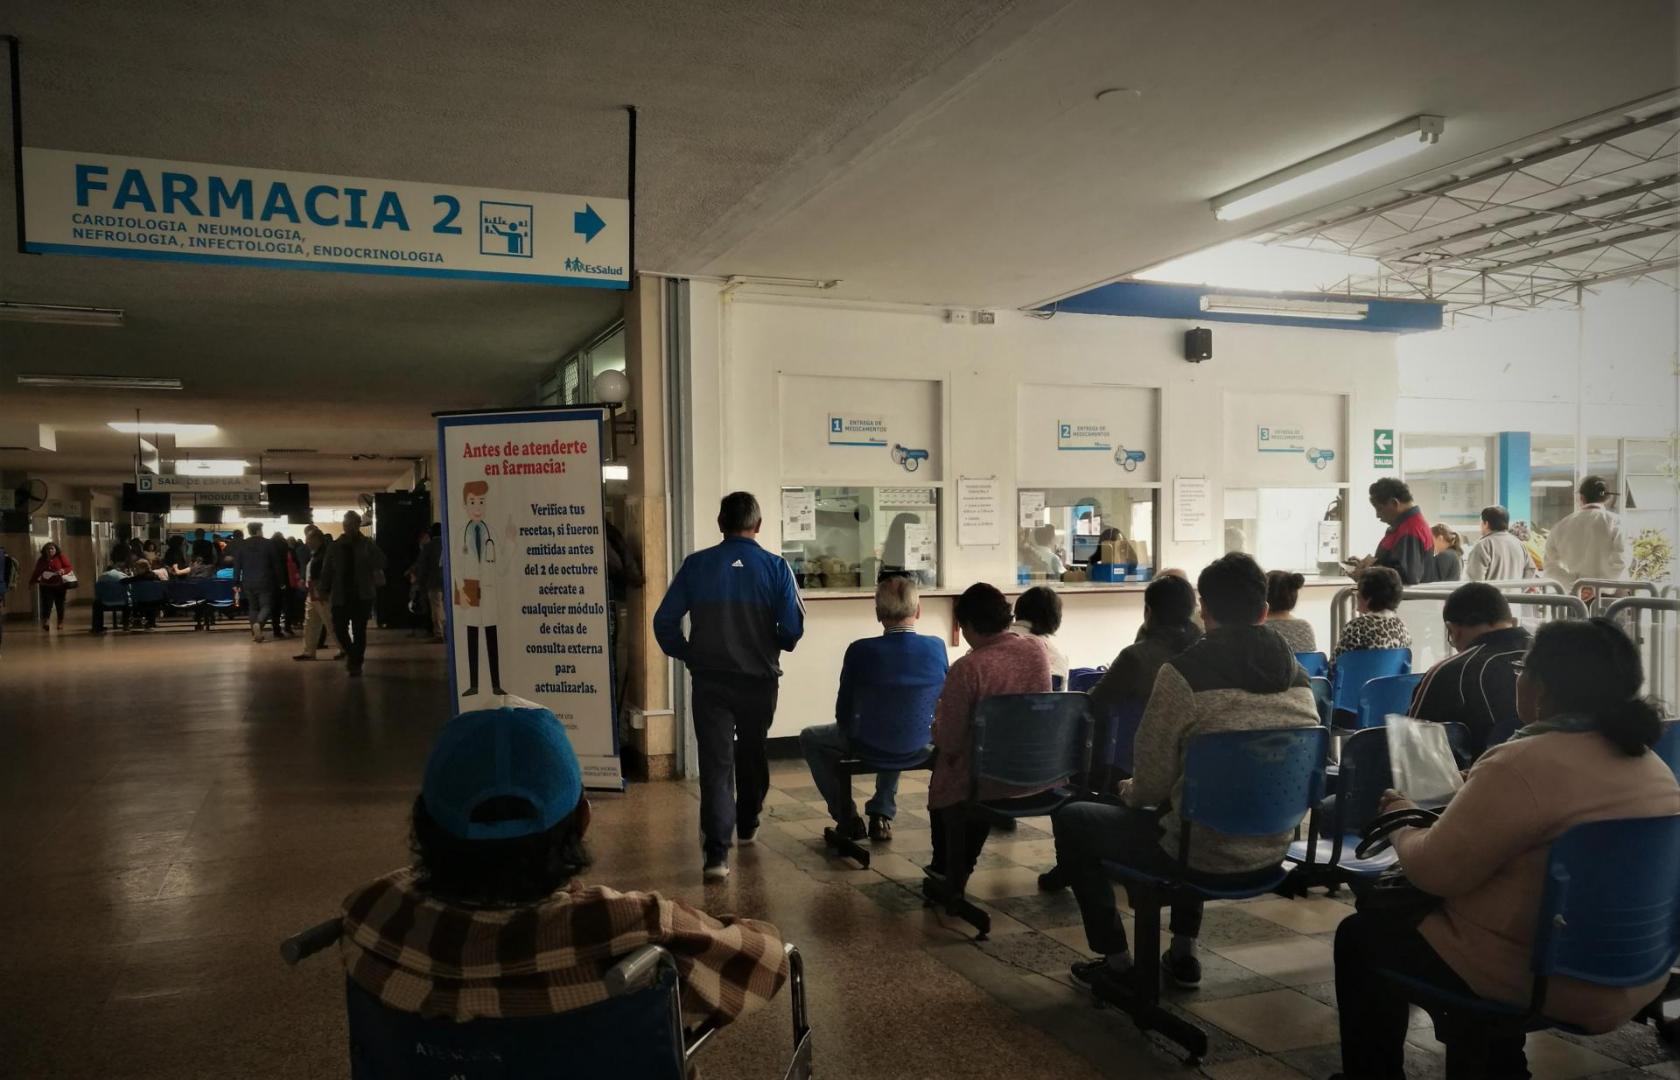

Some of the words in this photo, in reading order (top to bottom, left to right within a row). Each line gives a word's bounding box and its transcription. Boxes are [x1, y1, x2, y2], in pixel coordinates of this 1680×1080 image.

[75, 164, 410, 231] FARMACIA
[432, 194, 463, 235] 2
[72, 213, 188, 232] CARDIOLOGIA
[198, 223, 306, 242] NEUMOLOGIA,
[73, 228, 185, 248] NEFROLOGIA,
[188, 237, 310, 257] INFECTOLOGIA,
[313, 245, 444, 263] ENDOCRINOLOGIA
[585, 264, 623, 275] EsSalud
[833, 420, 841, 431] 1
[1062, 426, 1070, 437] 2
[1262, 429, 1268, 440] 3
[463, 442, 501, 458] Antes
[503, 441, 519, 457] de
[522, 439, 587, 456] atenderte
[484, 463, 500, 476] en
[502, 458, 566, 476] farmacia:
[141, 479, 151, 490] D
[531, 503, 568, 516] Verifica
[569, 504, 585, 515] tus
[519, 525, 555, 537] recetas,
[557, 523, 564, 536] si
[566, 523, 599, 536] fueron
[526, 543, 566, 556] emitidas
[568, 544, 594, 555] antes
[524, 563, 539, 576] del
[540, 564, 546, 575] 2
[548, 563, 560, 575] de
[561, 563, 598, 575] octubre
[538, 582, 577, 595] acércate
[578, 585, 585, 595] a
[522, 602, 566, 618] cualquier
[568, 602, 604, 615] módulo
[540, 622, 551, 634] de
[553, 622, 574, 634] citas
[576, 622, 587, 634] de
[526, 642, 566, 654] consulta
[568, 644, 603, 654] externa
[555, 664, 576, 676] para
[535, 681, 597, 694] actualizarlas.
